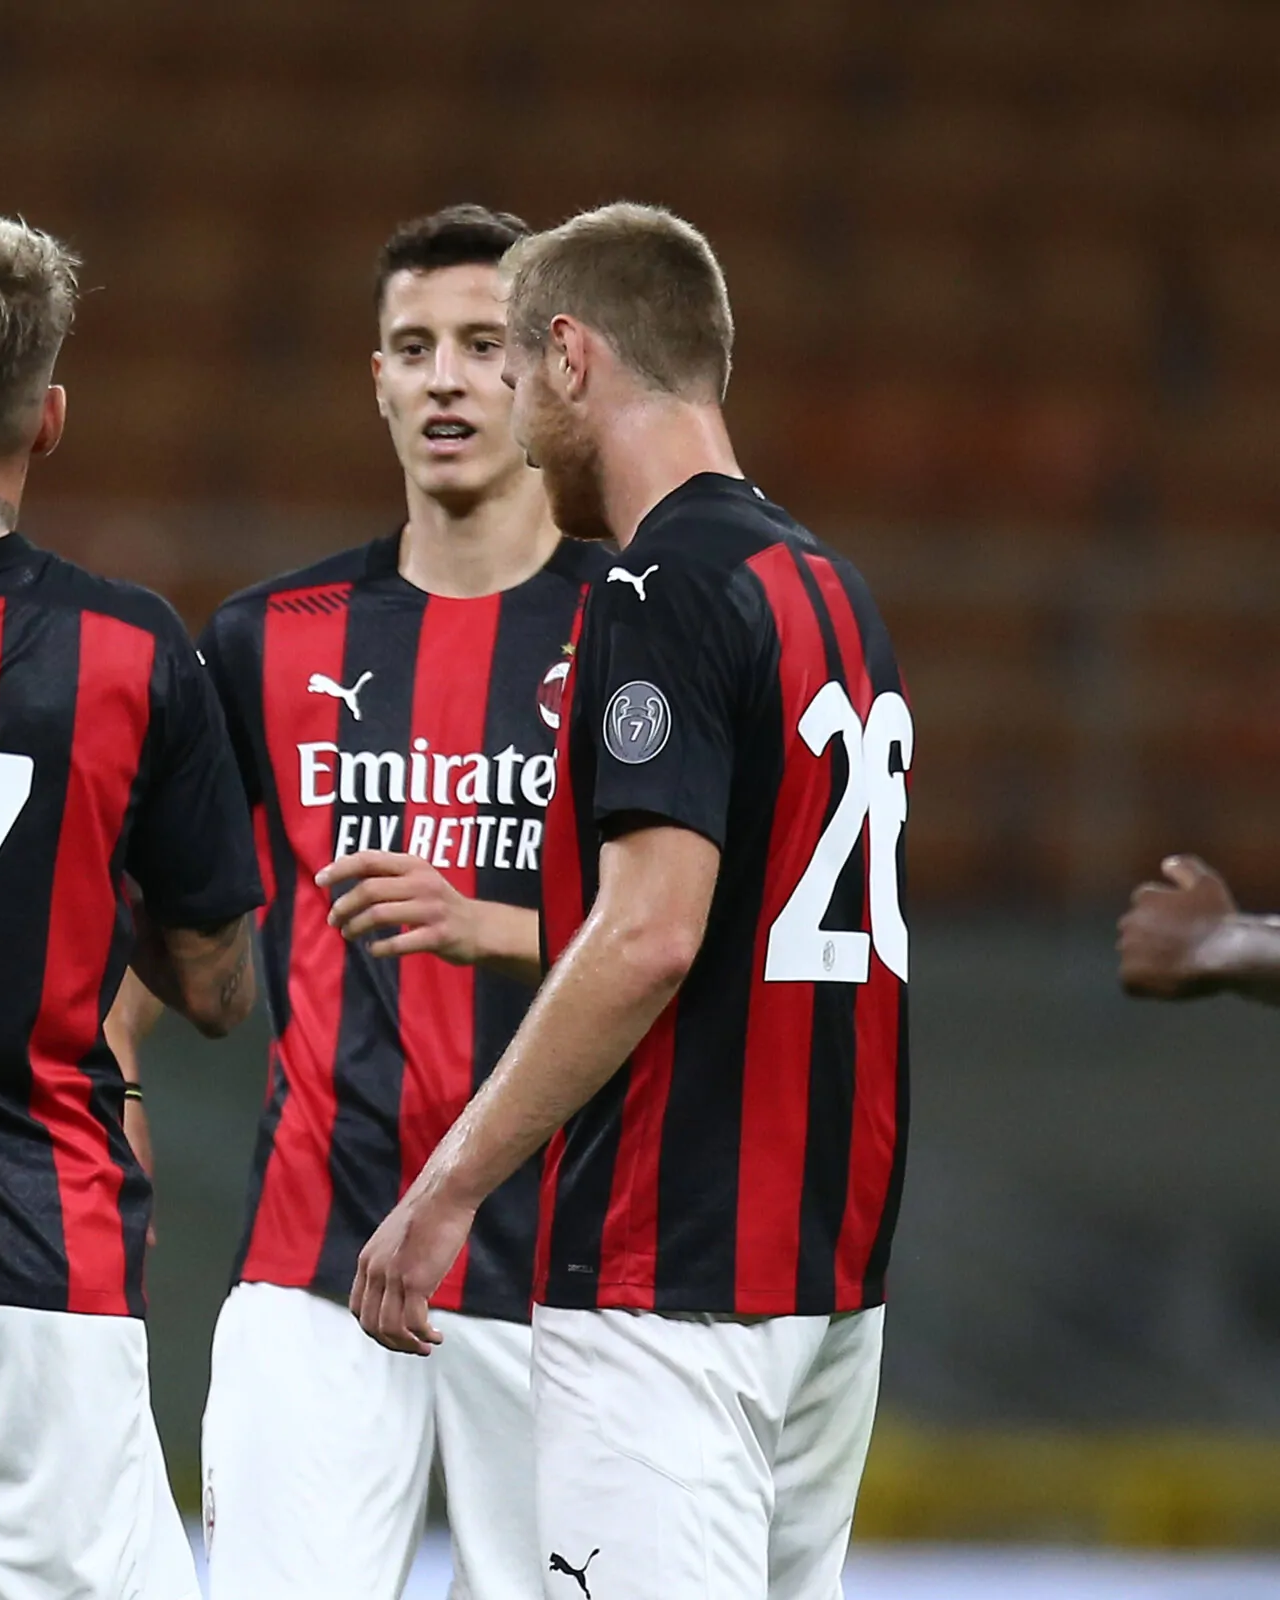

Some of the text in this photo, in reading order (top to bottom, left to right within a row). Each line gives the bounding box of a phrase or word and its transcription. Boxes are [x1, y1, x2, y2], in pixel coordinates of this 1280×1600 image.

[629, 721, 643, 741] 7
[296, 737, 558, 807] Emirate
[407, 815, 543, 870] BETTER
